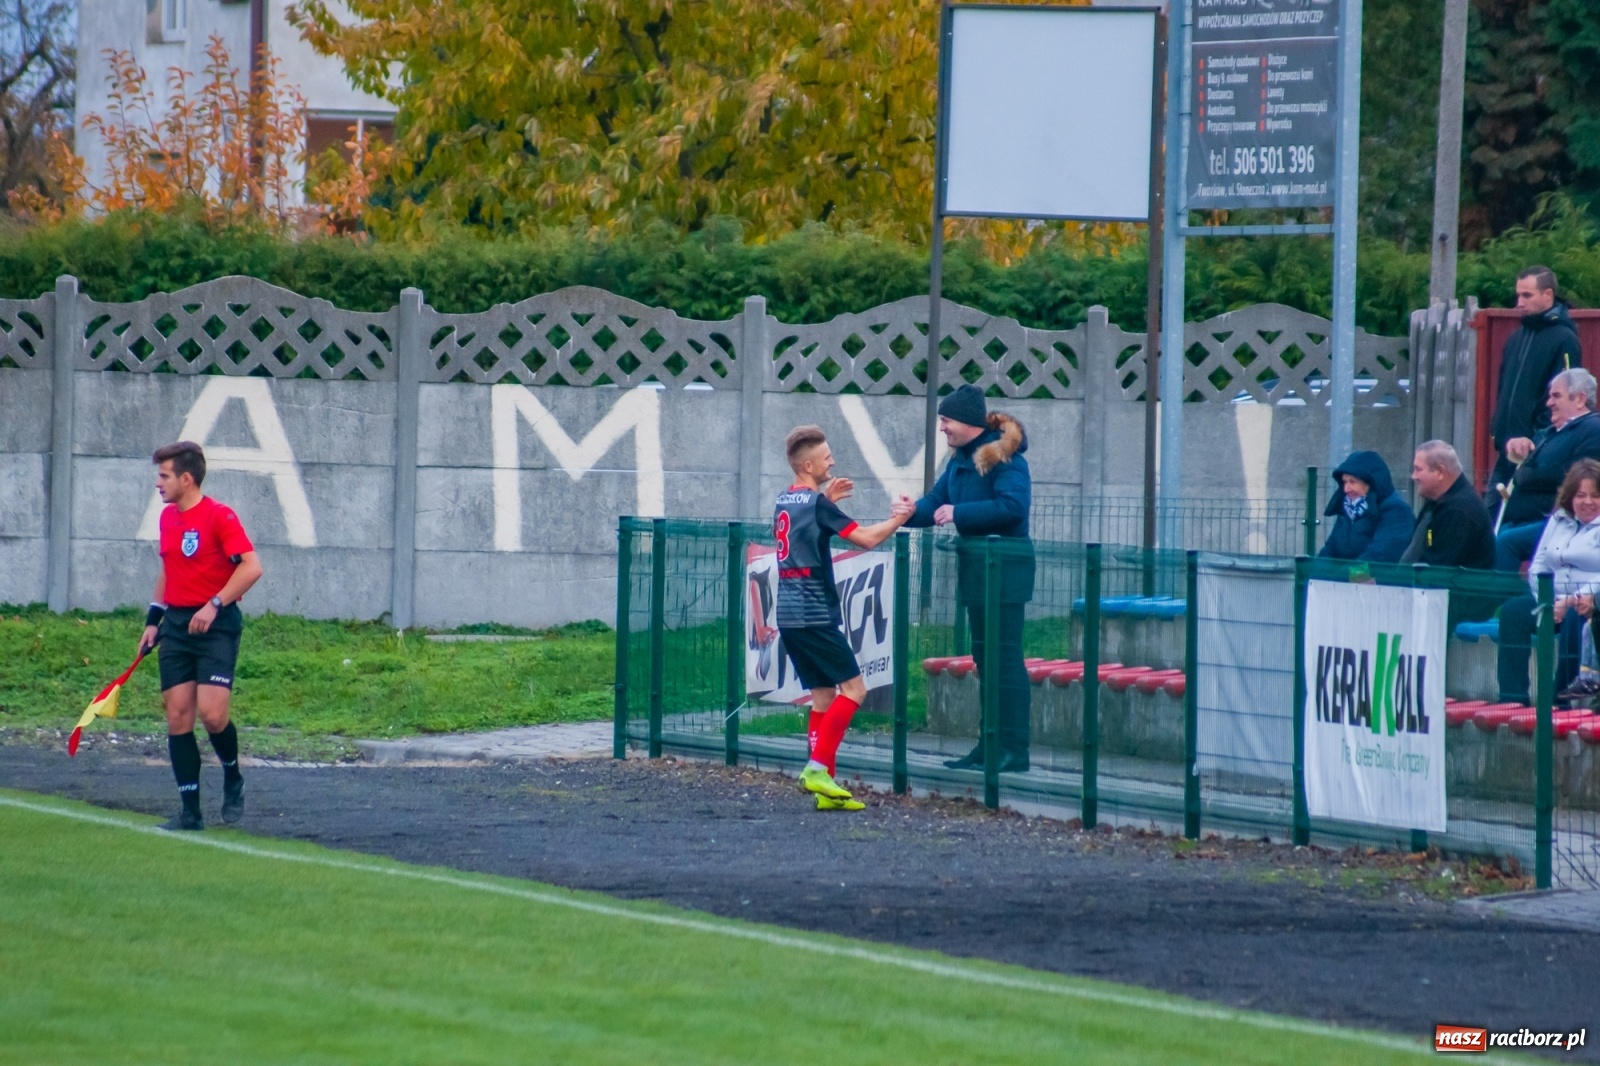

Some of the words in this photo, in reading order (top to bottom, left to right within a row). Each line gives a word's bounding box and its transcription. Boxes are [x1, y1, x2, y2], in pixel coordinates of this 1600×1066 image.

[1198, 13, 1241, 28] WYPOŻYCZALNIA
[1242, 11, 1278, 26] SAMOCHODÓW
[1279, 11, 1294, 24] ORAZ
[1295, 10, 1324, 24] PRZYCZEP
[1208, 56, 1236, 70] Samochody
[1236, 54, 1259, 66] osobowe
[1210, 147, 1229, 175] tel.
[1233, 147, 1256, 174] 506
[1260, 146, 1285, 174] 501
[1288, 145, 1315, 173] 396
[1316, 632, 1430, 736] KERAKOLL
